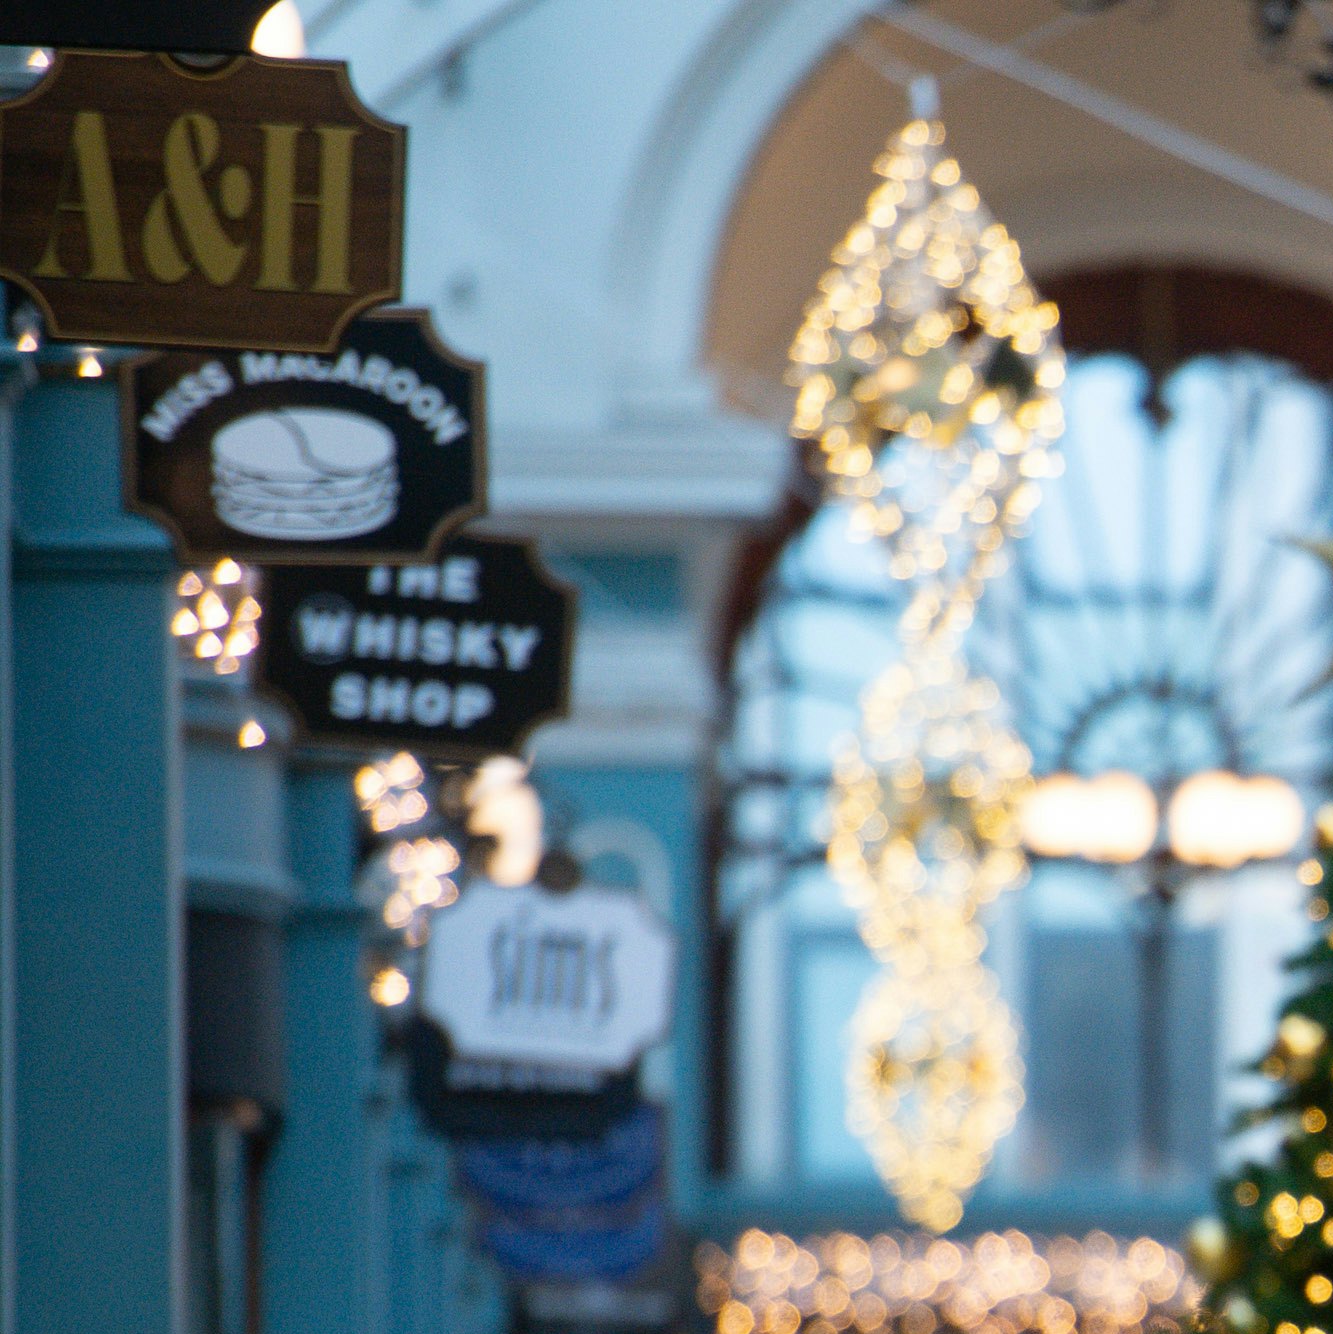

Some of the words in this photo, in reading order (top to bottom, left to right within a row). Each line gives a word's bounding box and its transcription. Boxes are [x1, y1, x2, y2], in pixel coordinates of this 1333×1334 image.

[29, 111, 362, 295] A&H
[141, 360, 234, 443] MISS
[239, 348, 470, 446] MACAROON
[299, 606, 541, 672] WHISKY
[330, 672, 495, 729] SHOP
